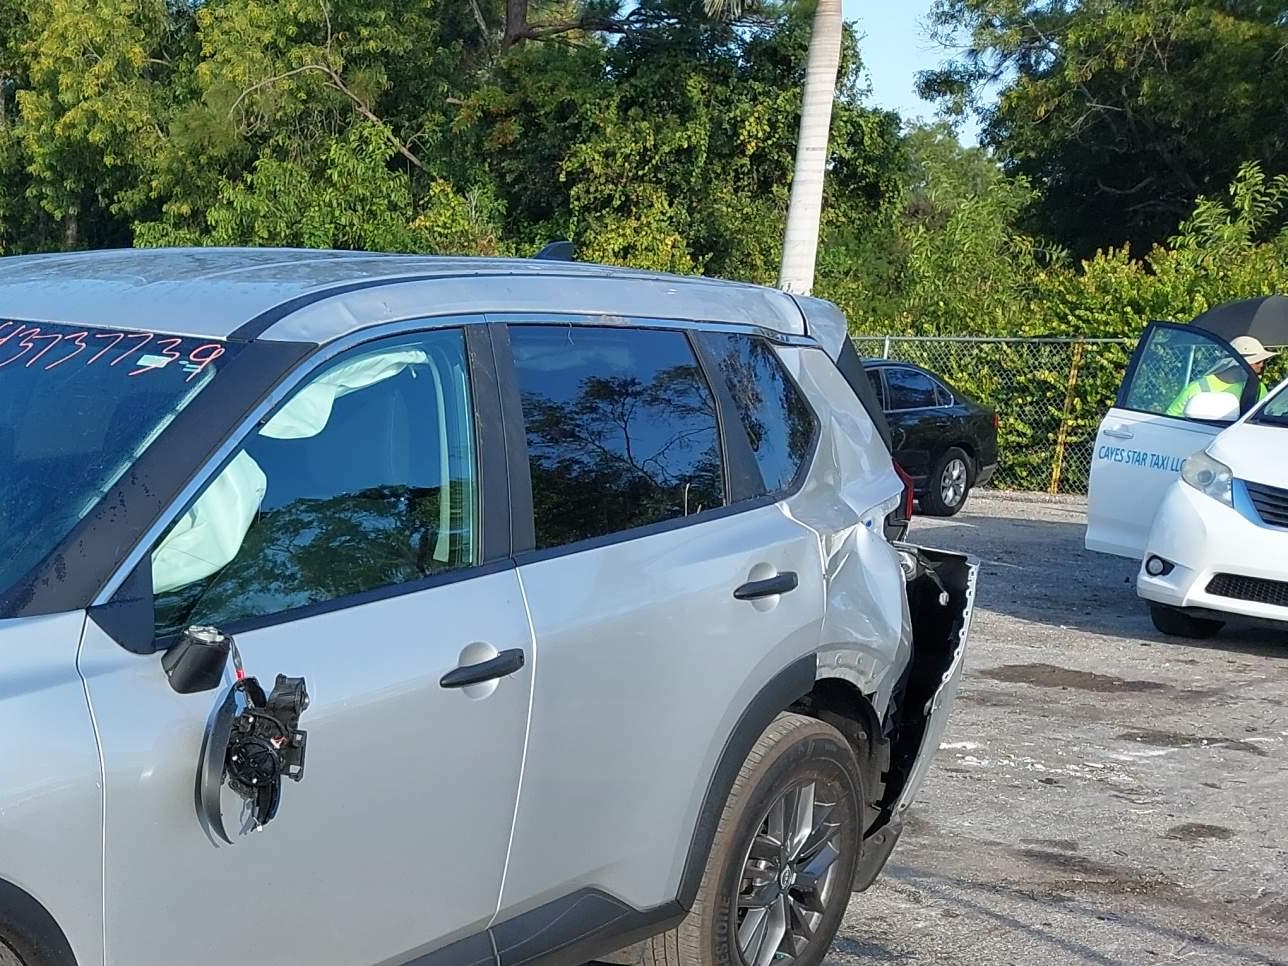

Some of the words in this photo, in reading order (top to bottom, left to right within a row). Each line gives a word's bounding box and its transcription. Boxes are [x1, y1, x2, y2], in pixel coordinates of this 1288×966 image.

[1099, 446, 1125, 462] CAYES
[1126, 450, 1148, 466] STAR
[1151, 454, 1170, 470] TAXI
